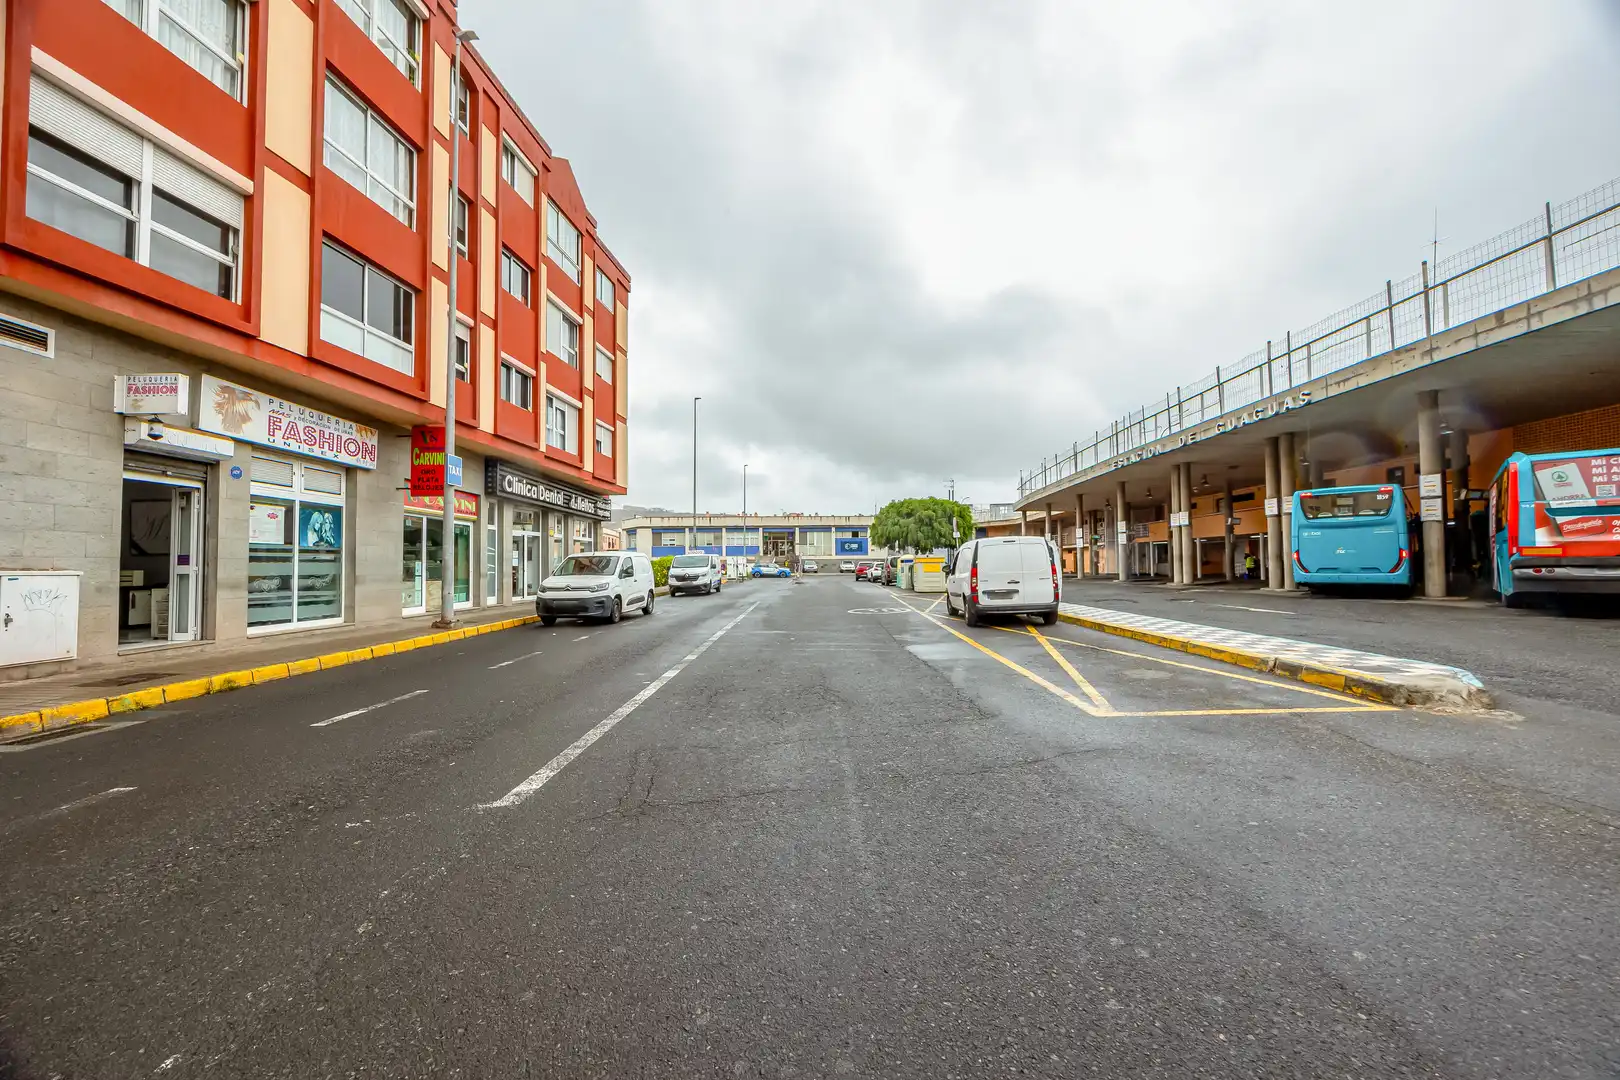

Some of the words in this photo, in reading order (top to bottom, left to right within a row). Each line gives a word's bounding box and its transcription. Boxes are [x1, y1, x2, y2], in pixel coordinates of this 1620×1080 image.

[127, 385, 179, 395] FASHION
[268, 398, 354, 431] PELUQUERIA
[1178, 432, 1197, 446] DE
[1216, 391, 1312, 433] GUAGUAS
[268, 415, 377, 462] FASHION
[268, 437, 339, 460] UNISEX
[539, 483, 564, 506] Dental
